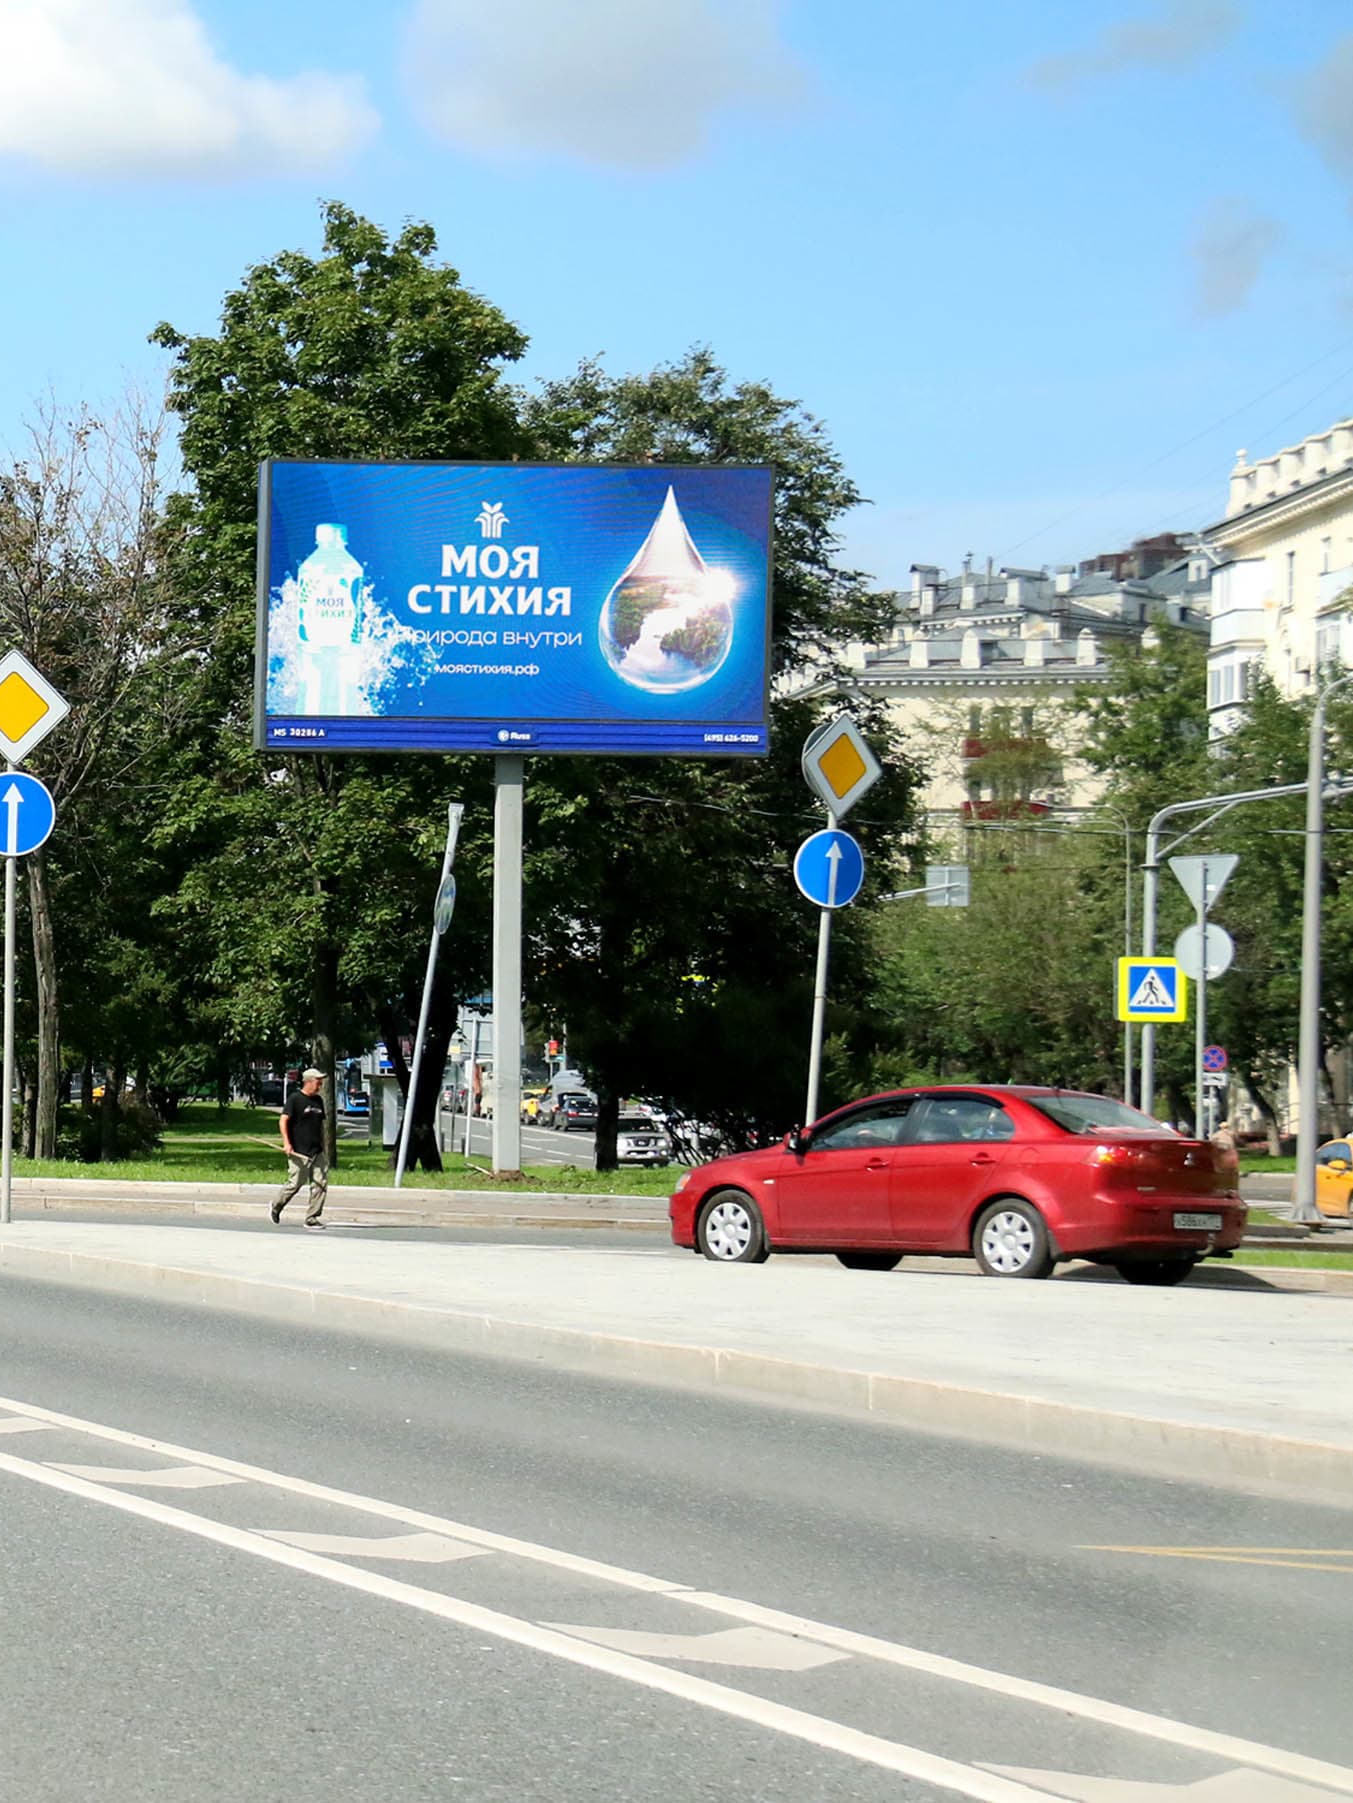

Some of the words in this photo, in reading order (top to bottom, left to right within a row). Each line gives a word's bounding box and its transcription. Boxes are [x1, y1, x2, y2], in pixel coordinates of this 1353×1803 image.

[441, 544, 540, 579] МОЯ
[407, 584, 572, 616] СТИХИЯ
[501, 631, 584, 649] внутри
